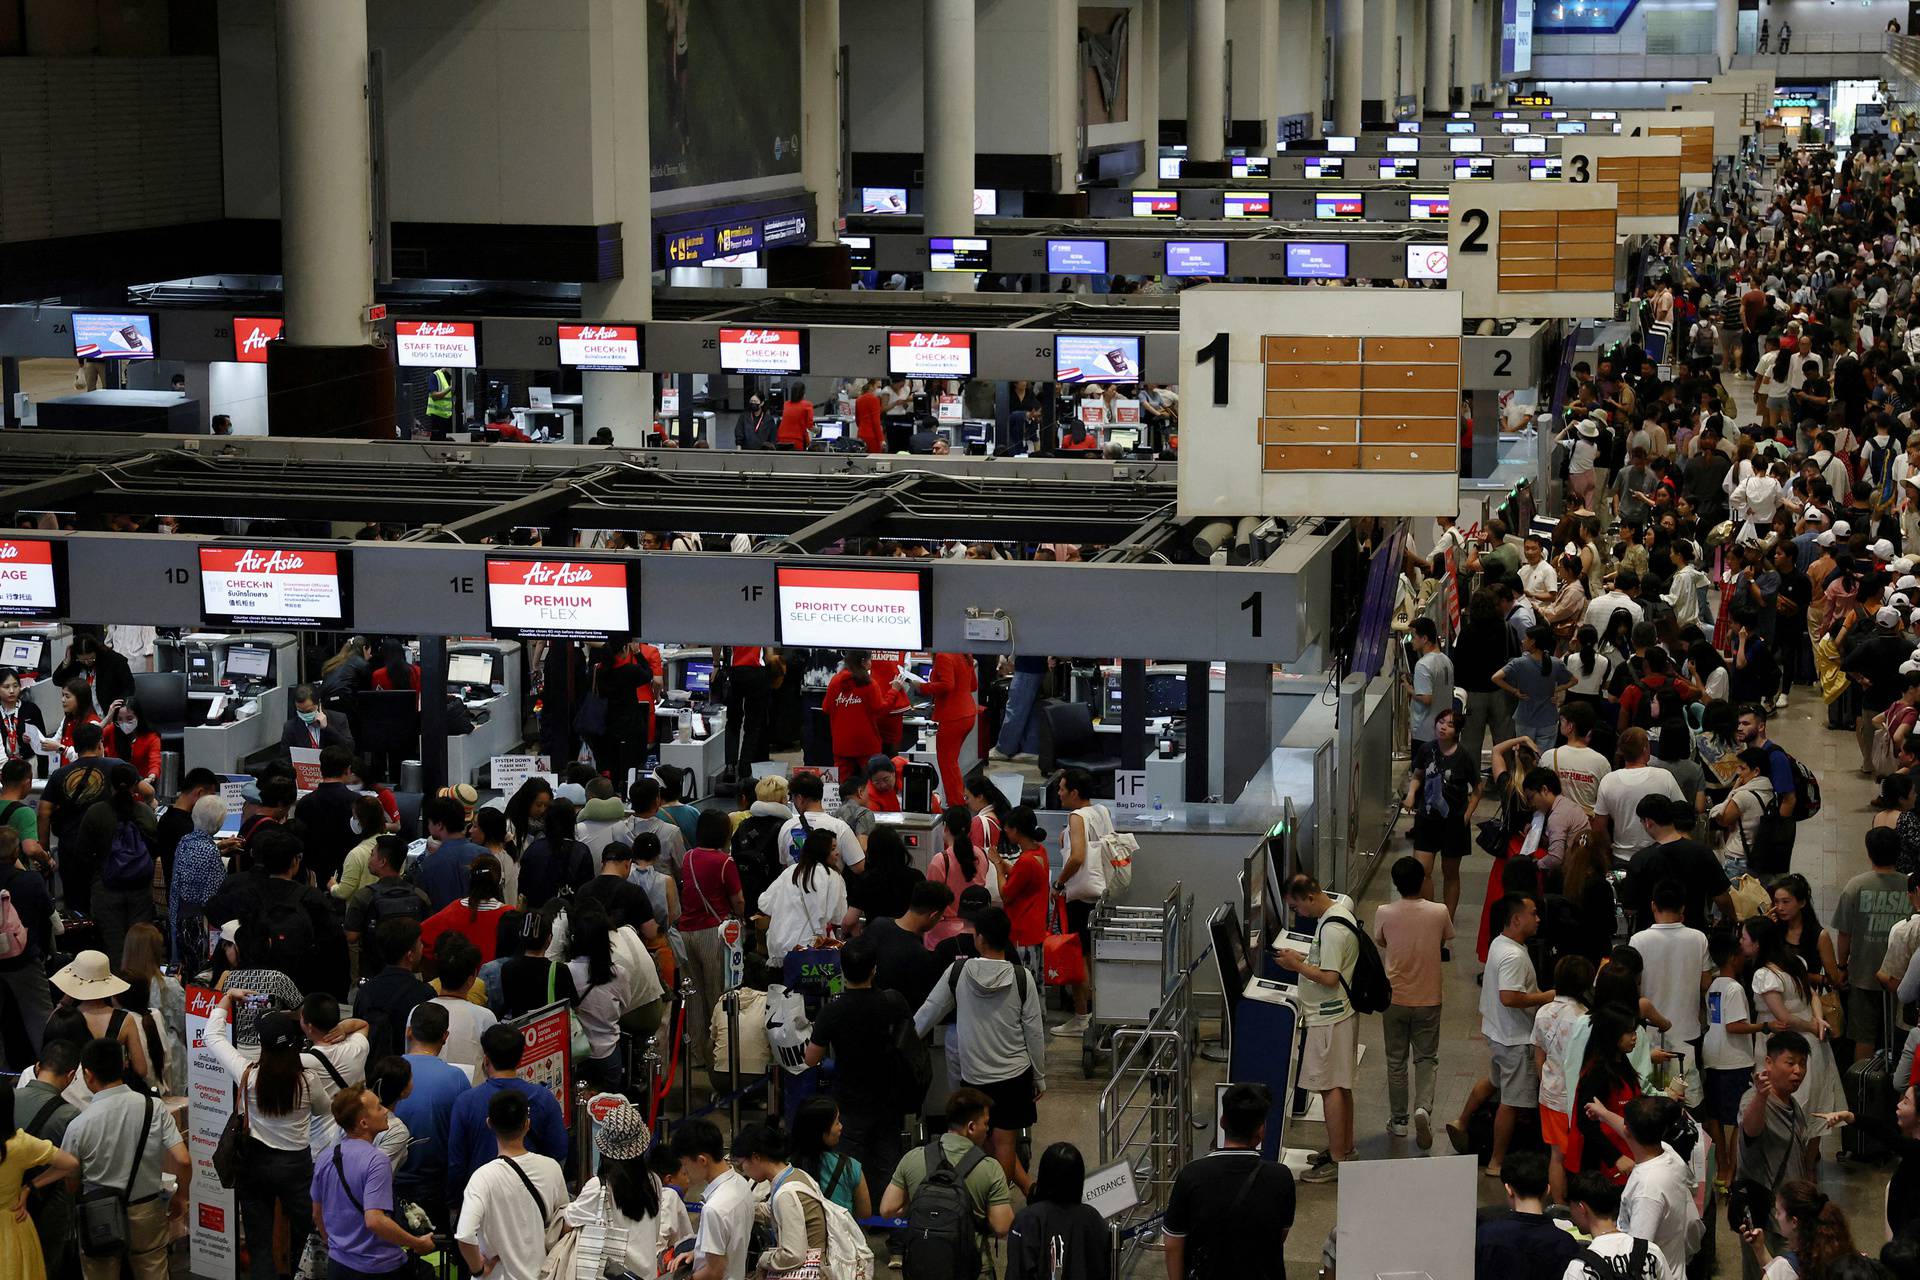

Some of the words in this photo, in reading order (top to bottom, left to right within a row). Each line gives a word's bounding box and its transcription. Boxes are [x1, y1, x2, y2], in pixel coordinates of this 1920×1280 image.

[1570, 155, 1590, 182] 3
[1460, 209, 1490, 252] 2
[53, 324, 67, 333] 2A
[214, 328, 228, 338] 2B
[538, 336, 552, 346] 2D
[702, 340, 716, 349] 2E
[868, 346, 881, 354] 2F
[1036, 348, 1051, 358] 2G
[915, 353, 960, 361] CHECK-IN
[1494, 350, 1511, 376] 2
[1196, 332, 1230, 406] 1
[165, 569, 189, 584] 1D
[226, 580, 273, 589] CHECK-IN
[450, 577, 473, 593] 1E
[741, 586, 763, 601] 1F
[524, 595, 591, 607] PREMIUM
[795, 602, 847, 611] PRIORITY
[851, 604, 905, 613] COUNTER
[540, 608, 577, 620] FLEX
[790, 612, 816, 621] SELF
[821, 613, 874, 623] CHECK-IN
[877, 615, 911, 624] KIOSK
[1240, 591, 1263, 637] 1
[1117, 775, 1145, 795] 1F
[801, 964, 834, 976] SAVE
[778, 1038, 810, 1066] NIK
[195, 1083, 225, 1096] Government
[1086, 1174, 1127, 1200] ENTRANCE
